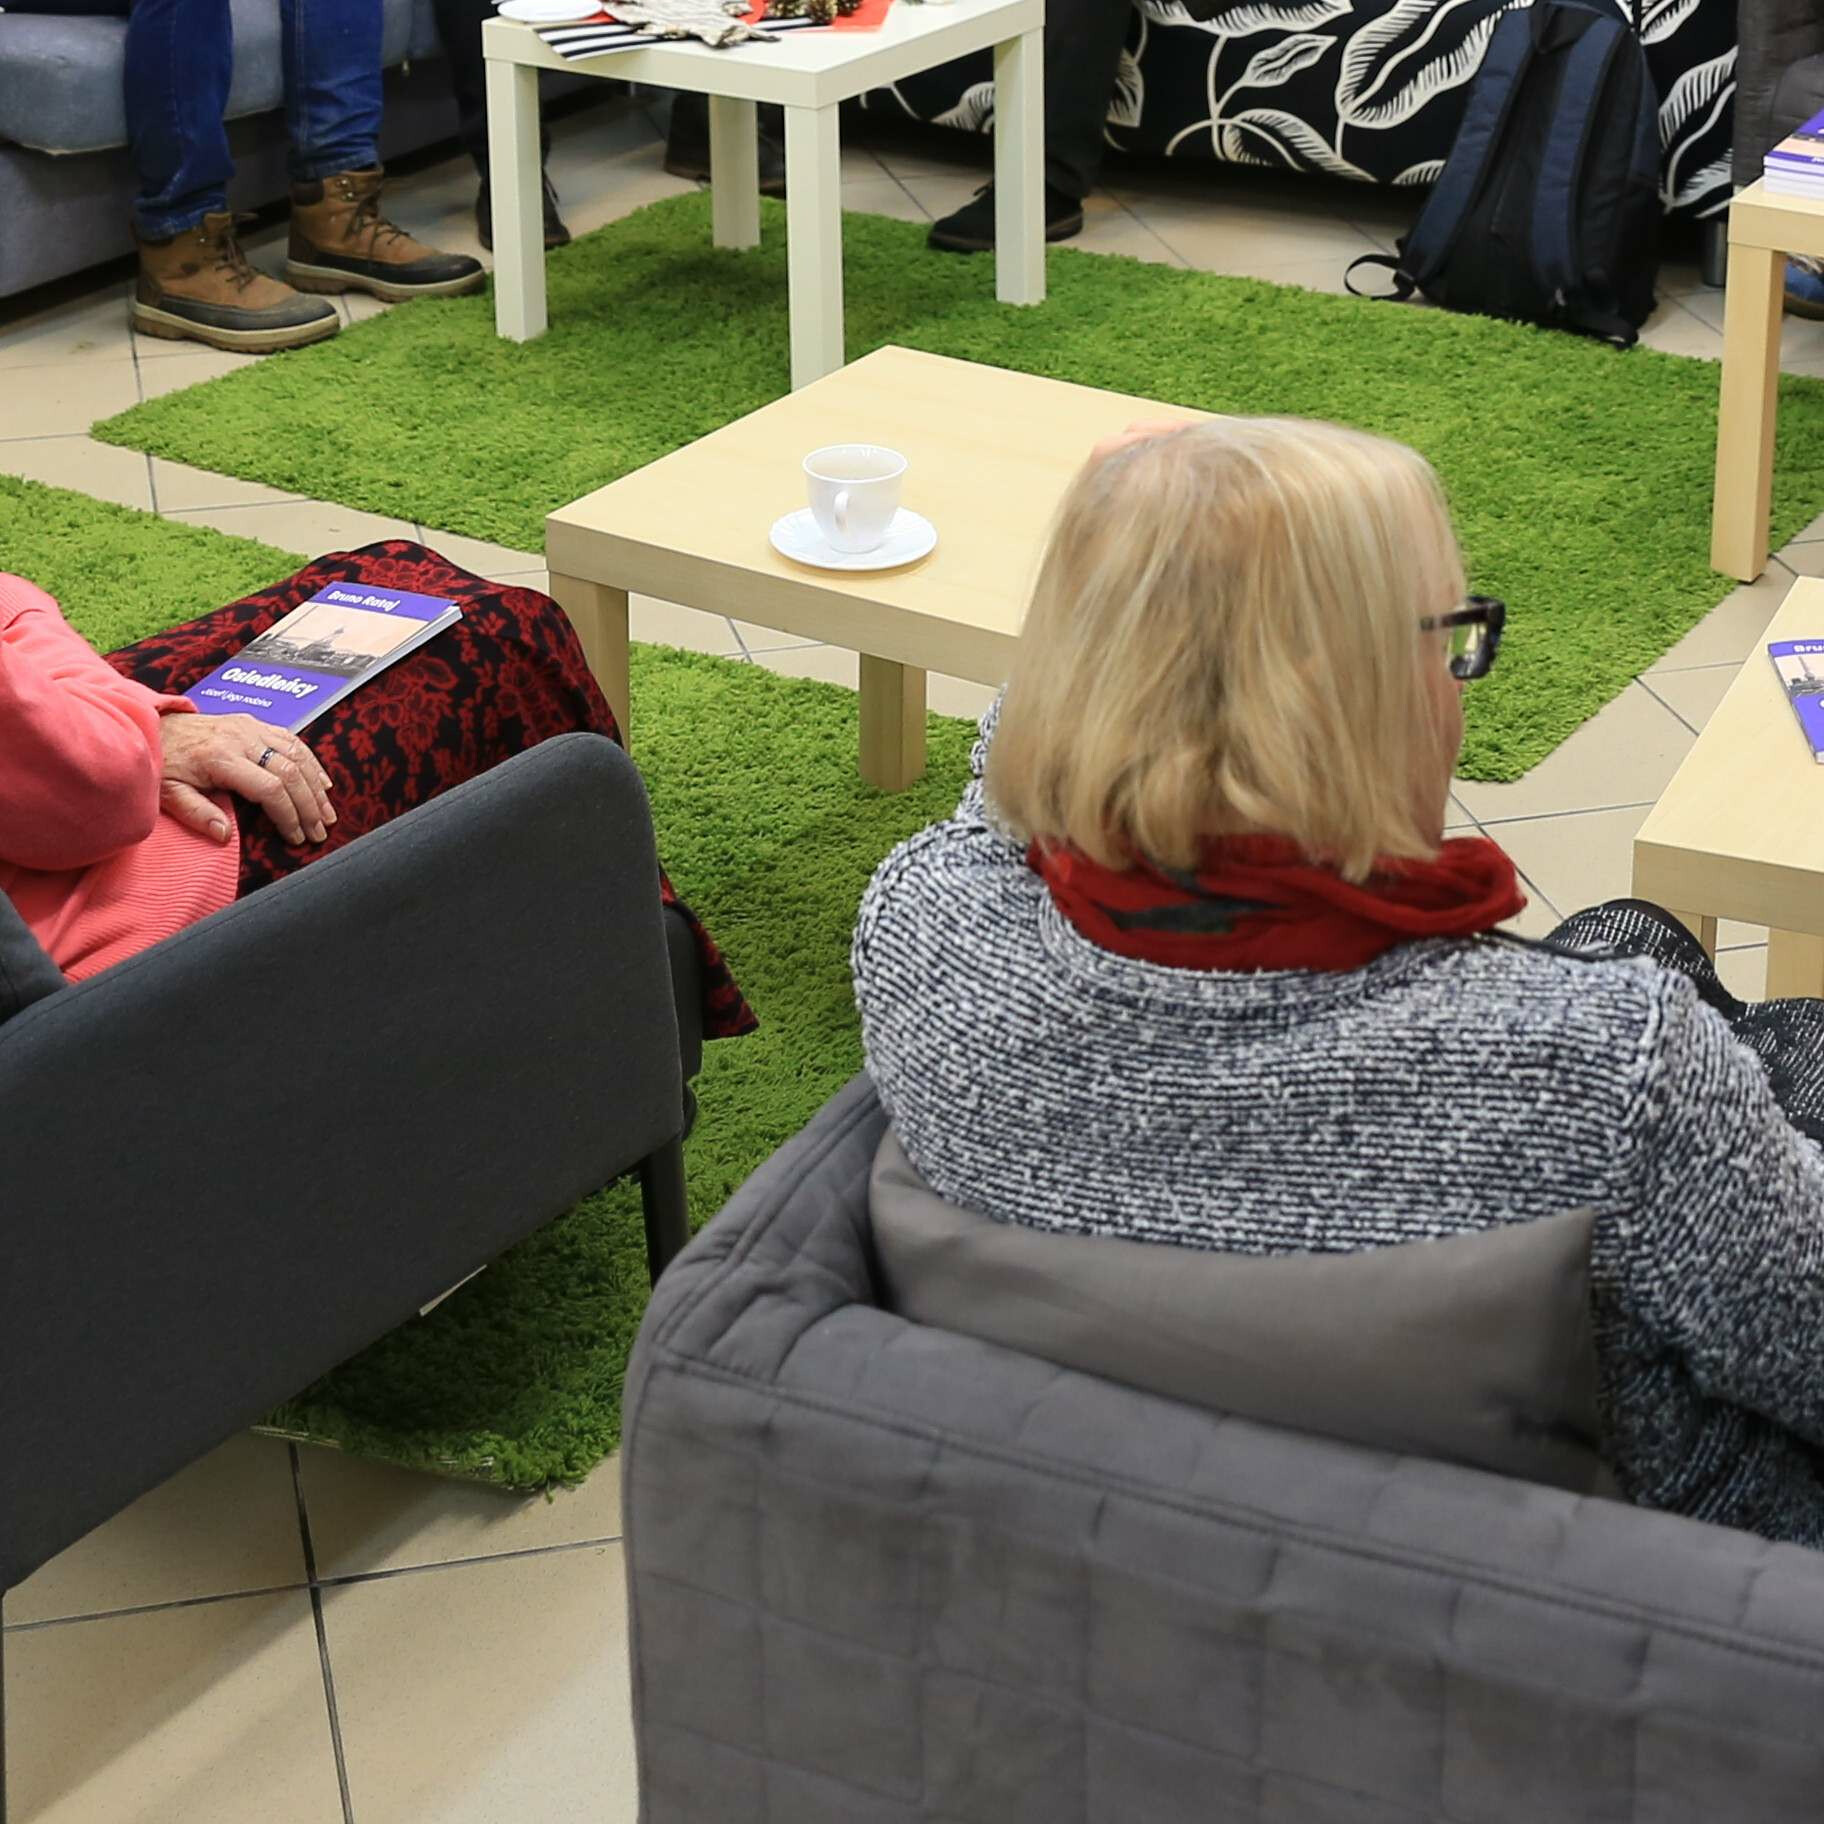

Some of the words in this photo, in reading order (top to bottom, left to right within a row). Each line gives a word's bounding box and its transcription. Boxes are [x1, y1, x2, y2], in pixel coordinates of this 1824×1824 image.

[327, 590, 363, 604] Bruno
[361, 595, 401, 612] Rataj
[221, 667, 318, 698] Osiedleńcy
